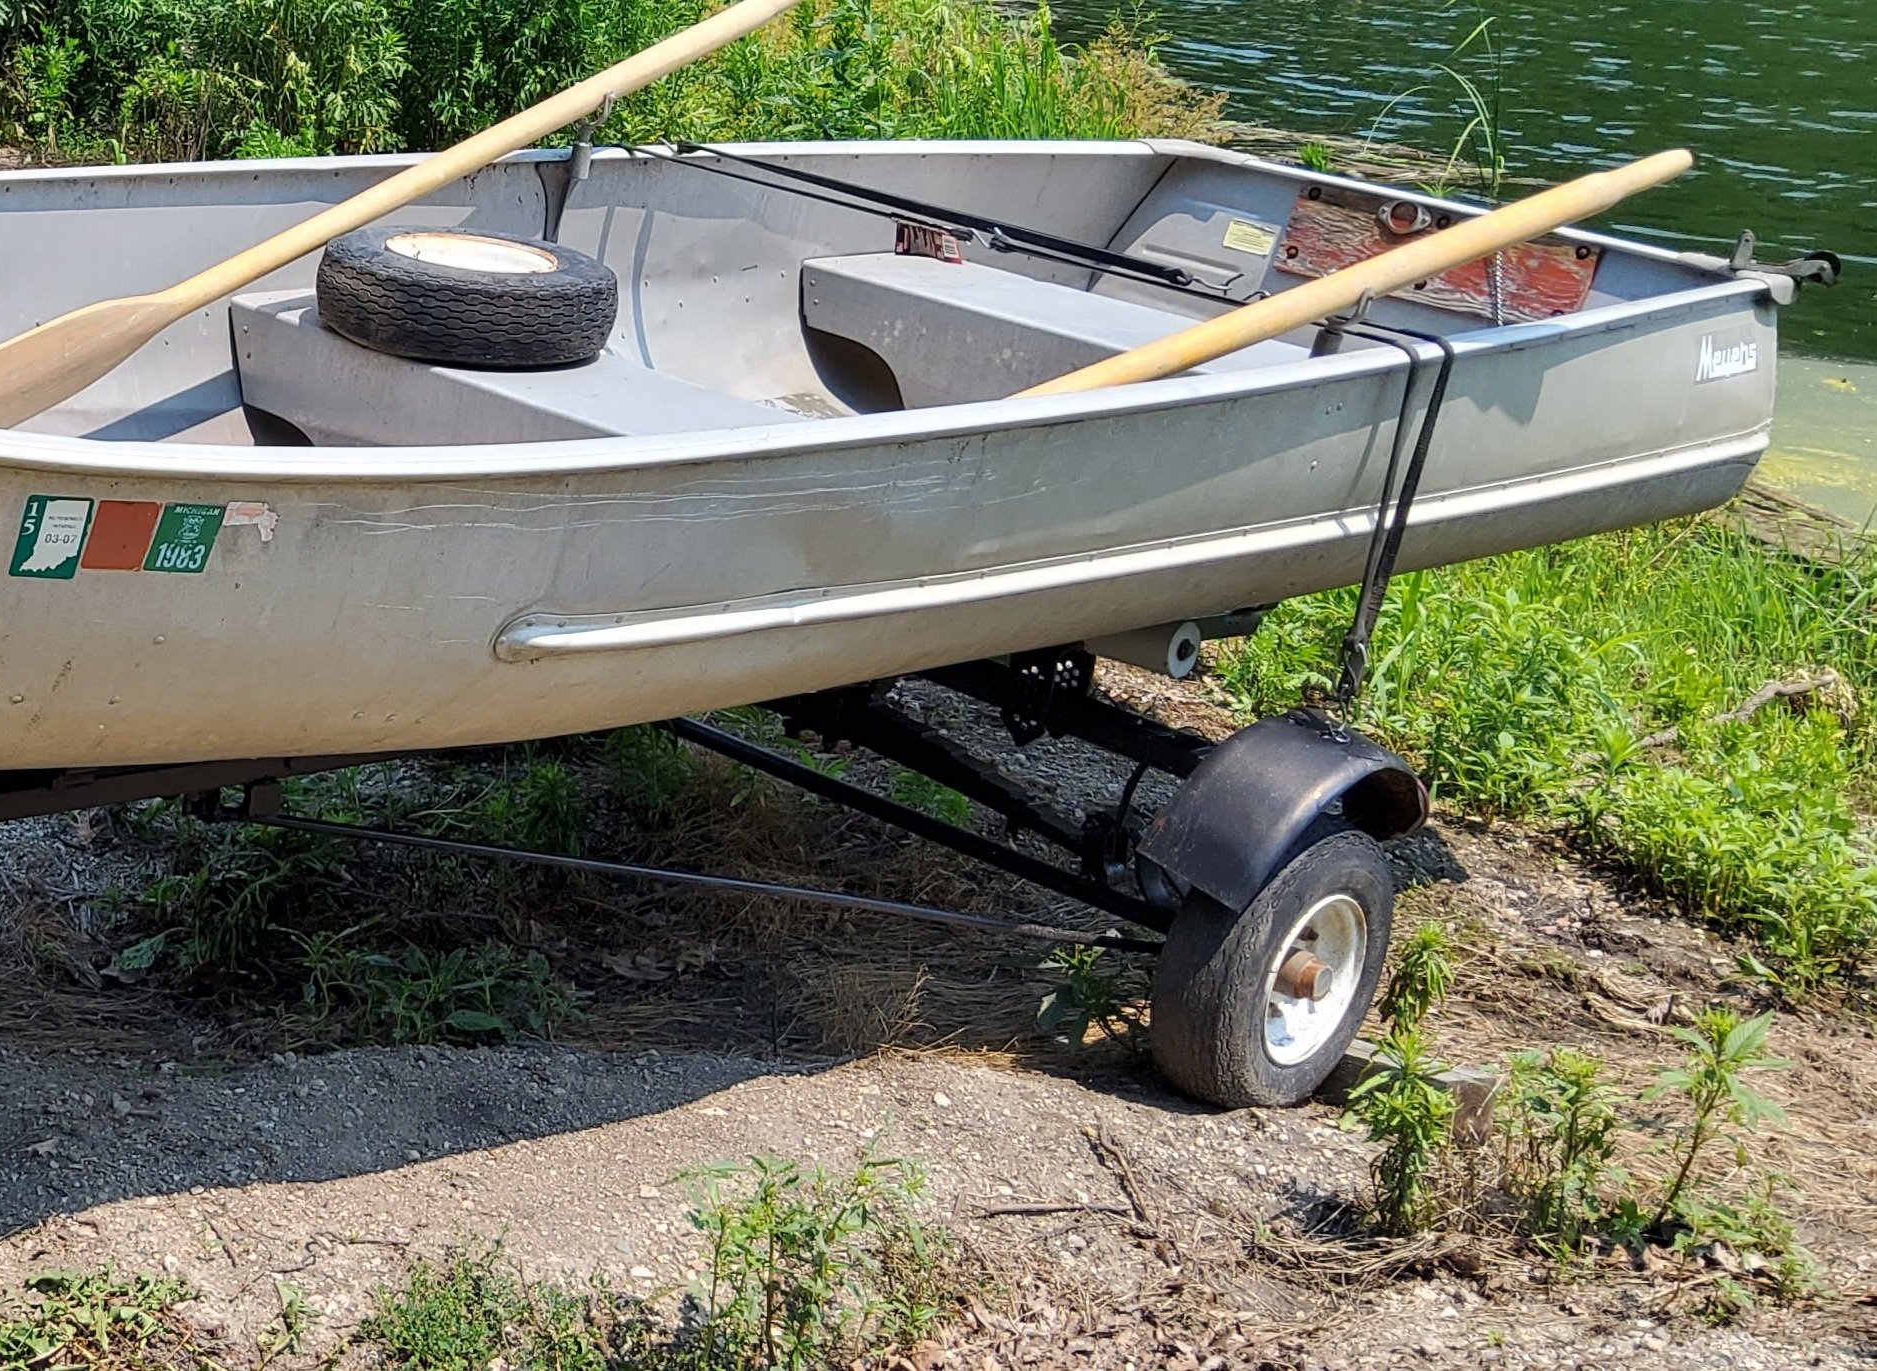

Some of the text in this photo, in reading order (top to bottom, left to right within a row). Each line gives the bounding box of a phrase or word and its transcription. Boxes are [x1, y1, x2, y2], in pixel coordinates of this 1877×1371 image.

[1695, 335, 1757, 381] Meyers
[174, 505, 221, 517] MICHIGAN
[44, 533, 78, 544] 03-07
[155, 542, 206, 569] 1983
